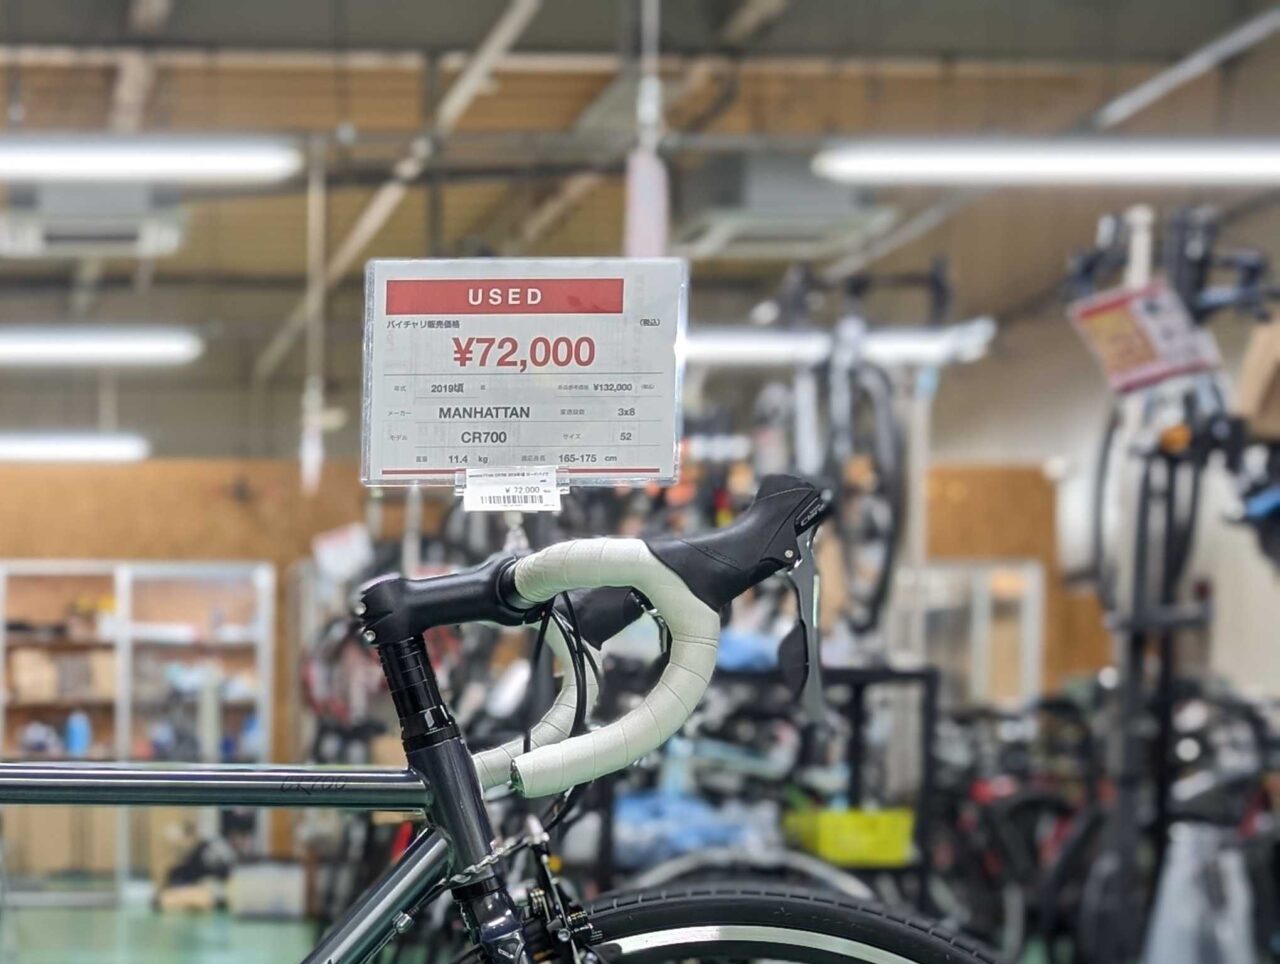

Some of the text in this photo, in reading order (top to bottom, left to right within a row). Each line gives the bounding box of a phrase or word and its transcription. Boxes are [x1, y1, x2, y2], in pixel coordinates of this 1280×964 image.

[468, 287, 543, 305] USED
[386, 319, 460, 330] バイチャリ販売価格
[452, 336, 596, 373] ¥72,000
[431, 383, 464, 393] 2019頃
[593, 383, 632, 392] ¥132,000
[438, 406, 531, 419] MANHATTAN
[617, 407, 636, 416] 3x8
[461, 431, 507, 444] CR700
[620, 432, 632, 441] 52
[448, 455, 469, 464] 11.4
[478, 455, 489, 465] kg
[558, 454, 598, 463] 165-175
[604, 455, 618, 463] cm
